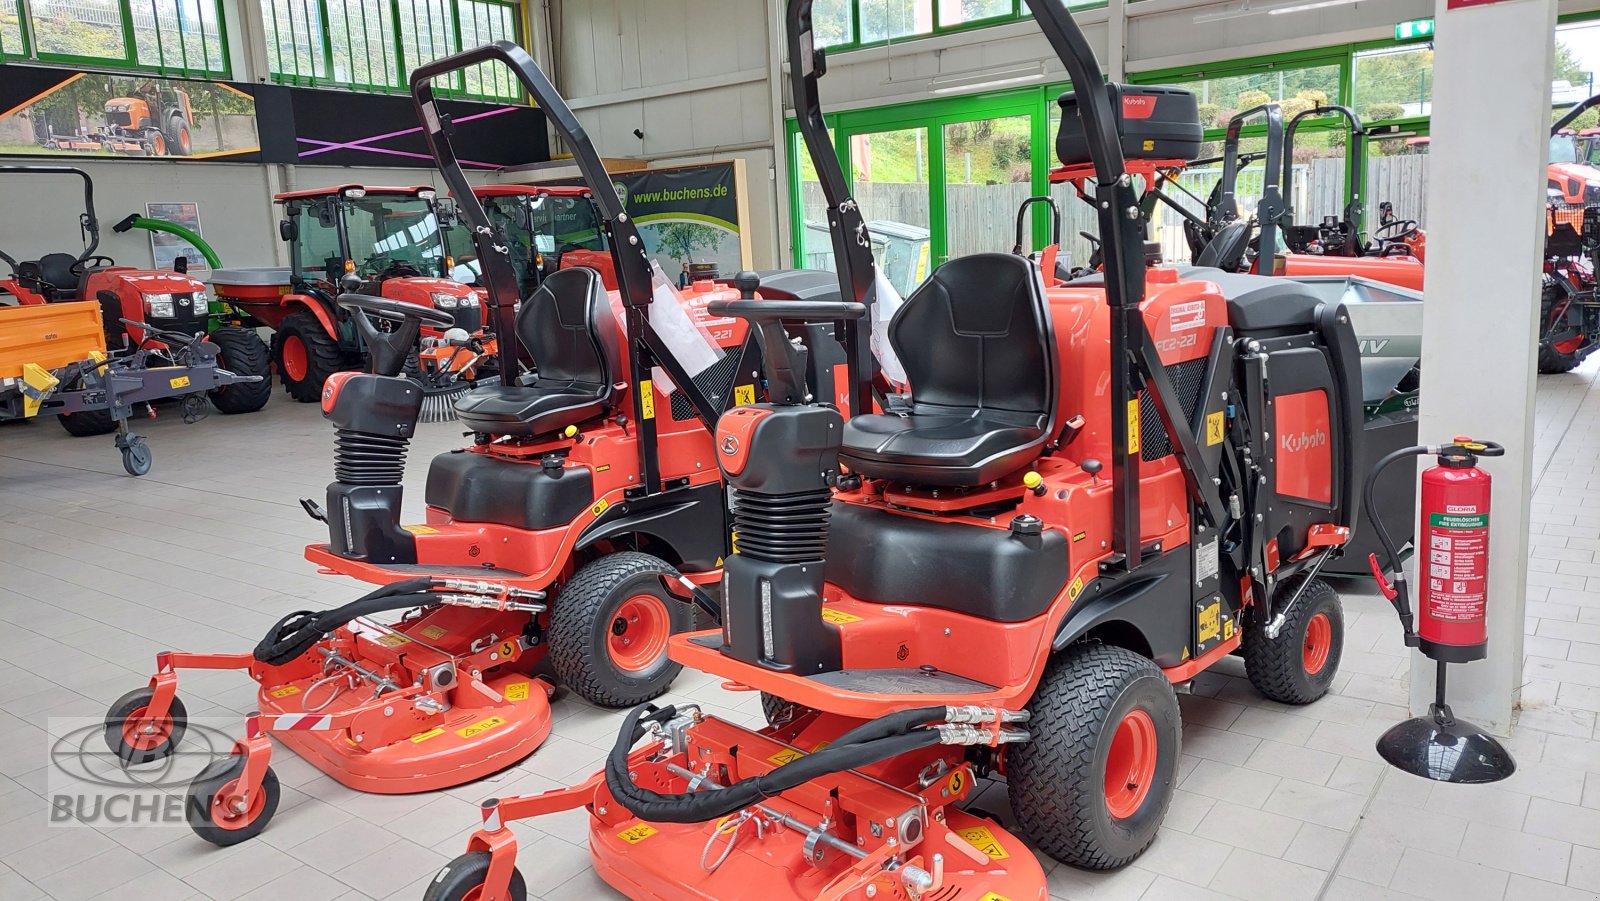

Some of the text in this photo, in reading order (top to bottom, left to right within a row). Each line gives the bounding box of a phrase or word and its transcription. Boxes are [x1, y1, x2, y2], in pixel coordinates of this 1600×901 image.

[1124, 97, 1146, 105] Kubota
[633, 183, 728, 204] www.buchens.de
[1281, 428, 1326, 453] Kubota
